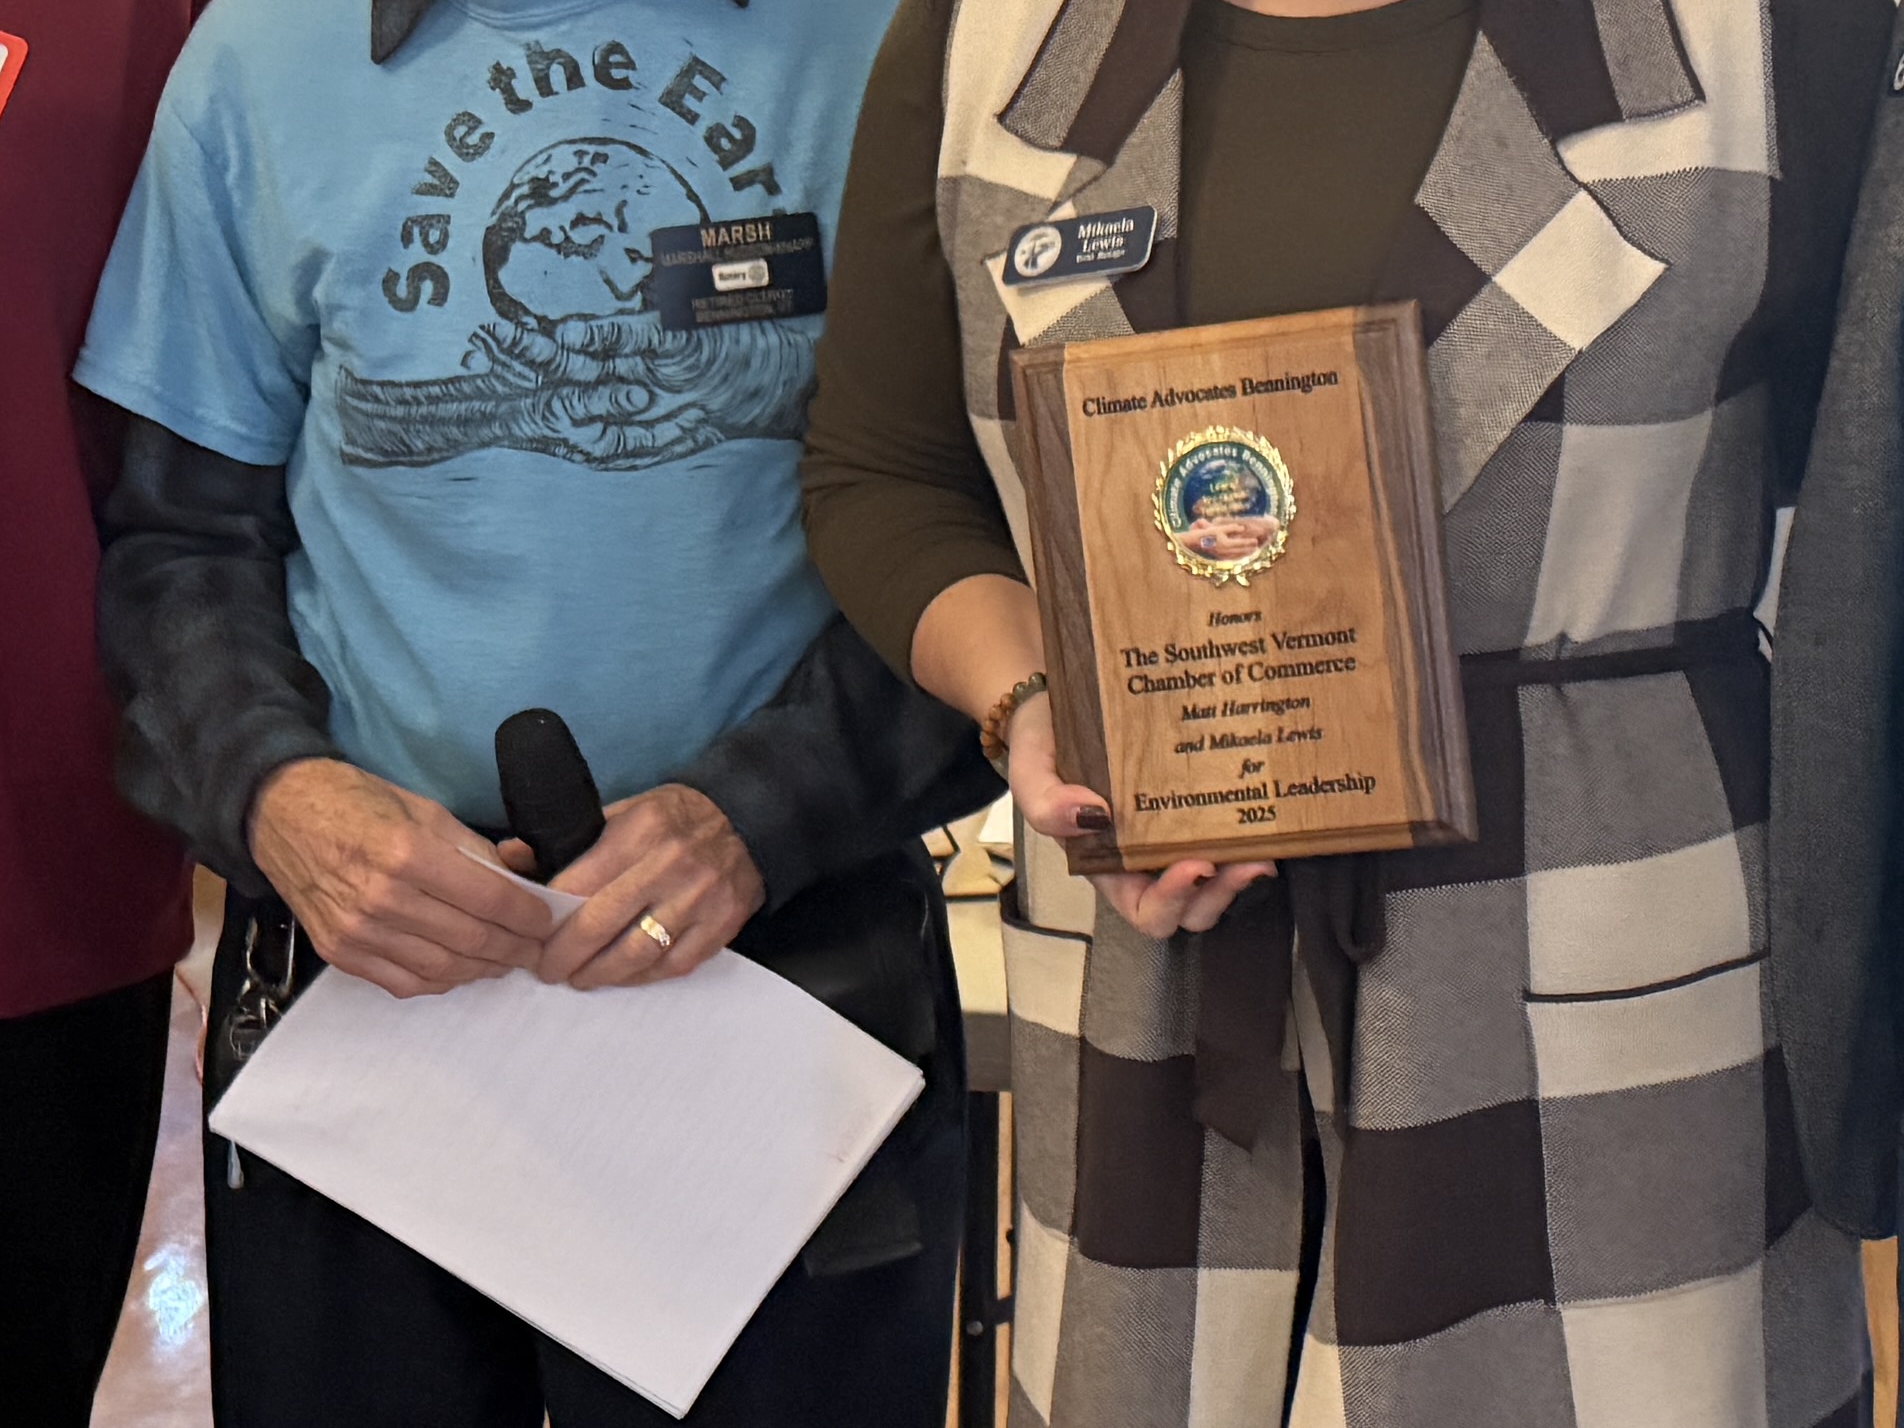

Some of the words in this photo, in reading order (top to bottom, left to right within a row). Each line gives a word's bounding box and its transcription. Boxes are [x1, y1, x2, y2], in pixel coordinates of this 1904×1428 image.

[382, 109, 495, 313] Save
[486, 39, 637, 115] the
[657, 52, 787, 216] Ear
[700, 222, 772, 248] MARSH
[1082, 395, 1147, 418] Climate
[1150, 383, 1237, 409] Advocates
[1240, 370, 1339, 397] Bennington
[1208, 610, 1262, 627] Honors
[1120, 648, 1159, 668] The
[1164, 637, 1267, 664] Southwest
[1271, 627, 1356, 651] Vermont
[1127, 670, 1216, 695] Chamber
[1222, 664, 1245, 685] of
[1248, 655, 1356, 682] Commerce
[1181, 702, 1216, 721] Matt
[1221, 696, 1311, 718] Harrington
[1174, 734, 1204, 754] and
[1209, 729, 1272, 750] Mikaela
[1277, 725, 1322, 743] Lewis
[1238, 758, 1265, 779] for
[1134, 783, 1269, 811] Environmental
[1274, 772, 1376, 798] Leadership
[1237, 805, 1276, 824] 2025
